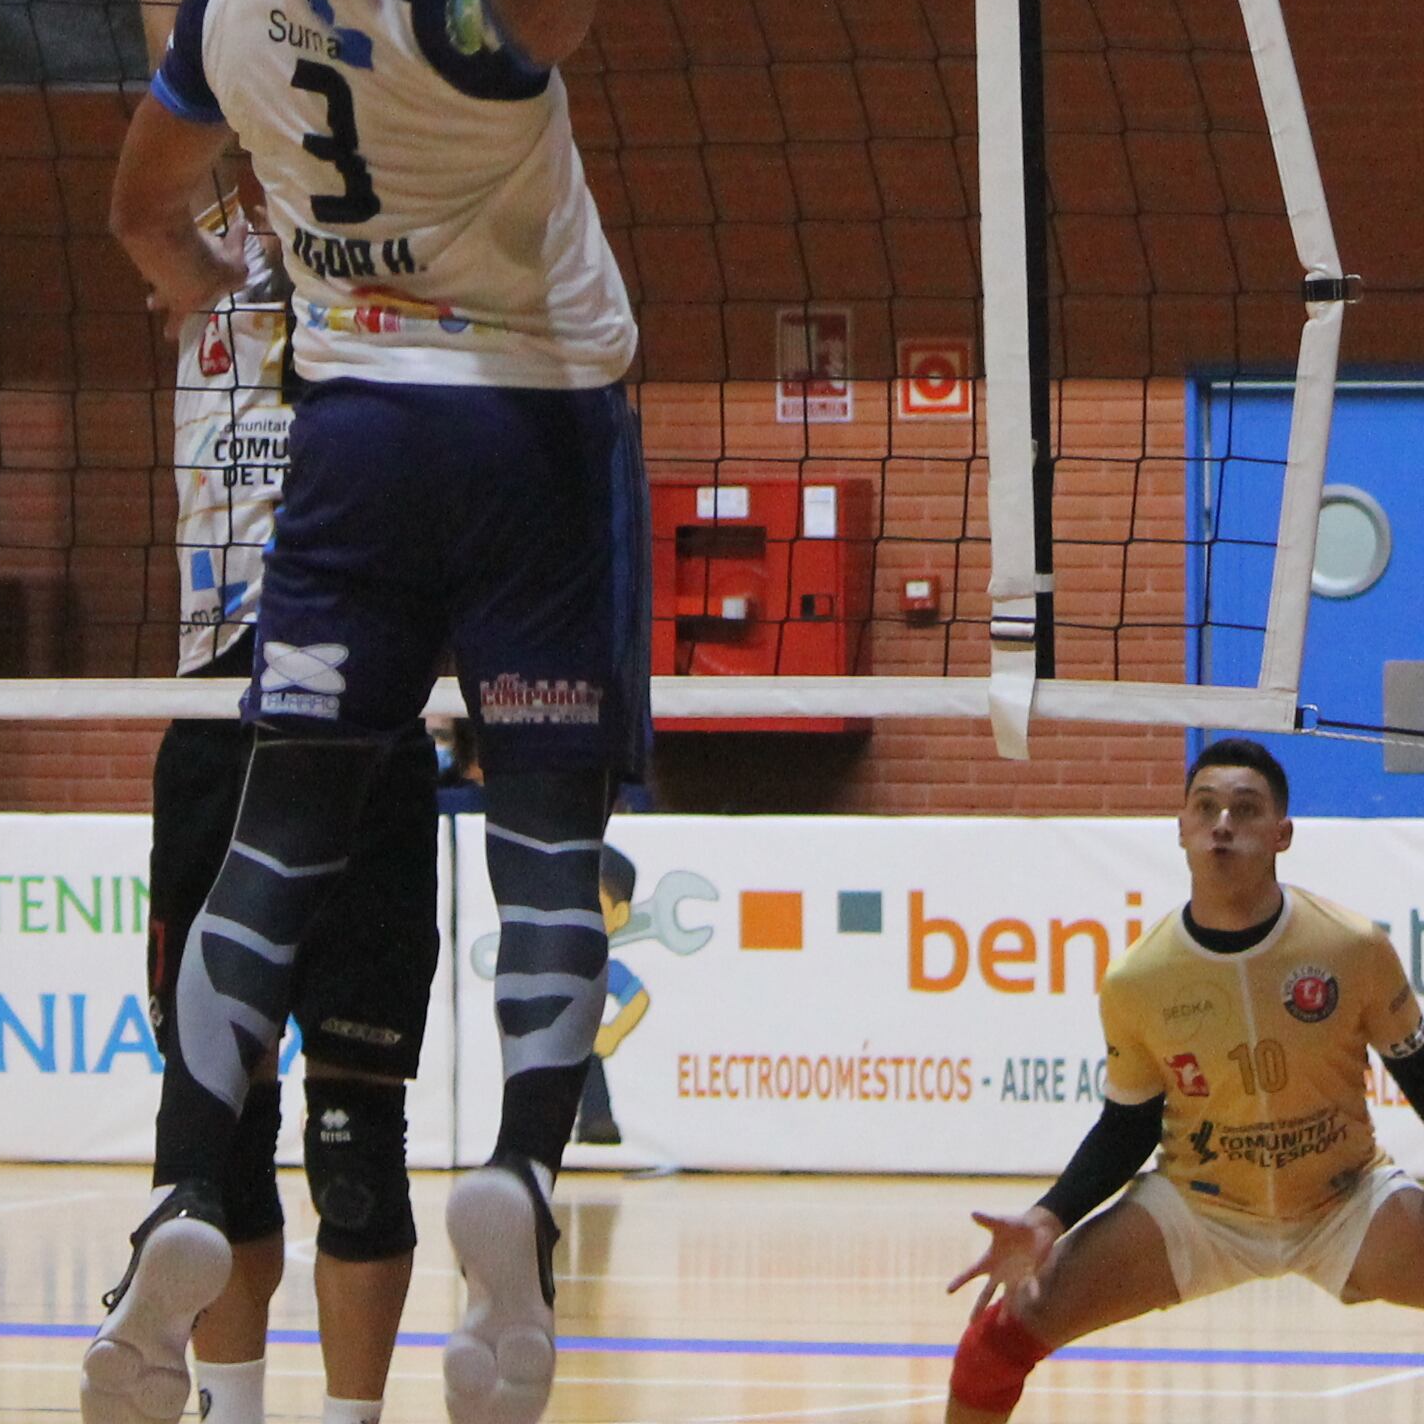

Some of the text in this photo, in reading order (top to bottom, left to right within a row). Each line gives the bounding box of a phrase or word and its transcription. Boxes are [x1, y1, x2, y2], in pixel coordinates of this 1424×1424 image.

[268, 9, 341, 60] Suma
[290, 58, 382, 224] 3
[677, 1040, 973, 1103] ELECTRODOMÉSTICOS
[1000, 1058, 1066, 1103] AIRE
[1226, 1038, 1289, 1097] 10
